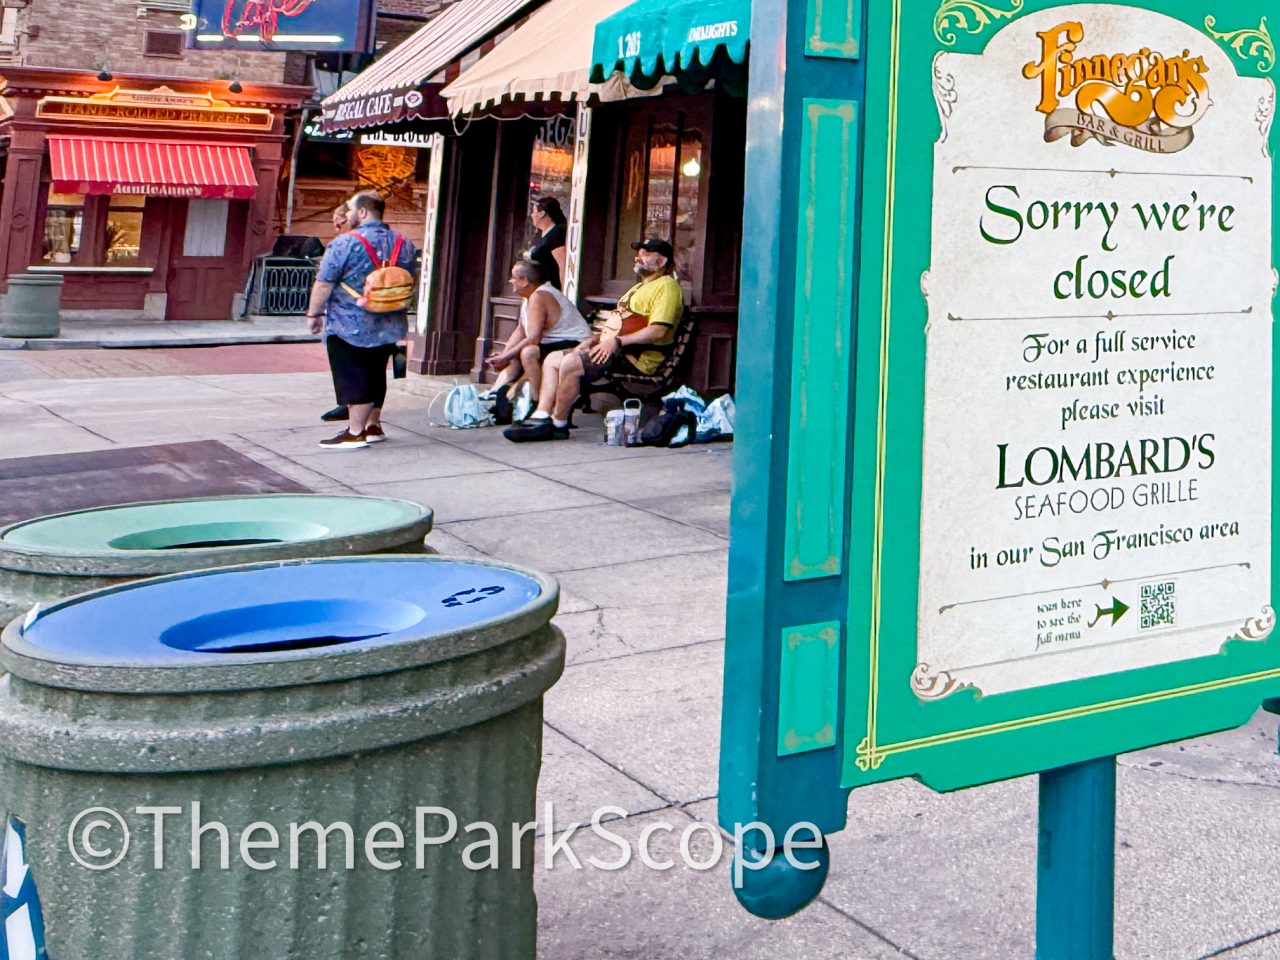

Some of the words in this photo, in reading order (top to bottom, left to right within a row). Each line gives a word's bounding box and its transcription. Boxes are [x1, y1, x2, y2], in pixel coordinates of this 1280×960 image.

[1022, 21, 1214, 128] Finnegan's
[334, 100, 365, 121] REGAL
[1077, 113, 1105, 133] BAR
[1124, 131, 1165, 152] GRILL
[980, 185, 1119, 252] Sorry
[1132, 190, 1235, 232] we're
[1054, 255, 1175, 300] closed
[1022, 333, 1069, 363] For
[1076, 339, 1087, 354] a
[1091, 330, 1126, 363] full
[1131, 329, 1196, 352] service
[1006, 368, 1109, 391] restaurant
[1117, 361, 1215, 392] experience
[1060, 399, 1120, 430] please
[1127, 394, 1165, 416] visit
[996, 433, 1216, 489] LOMBARD'S
[1014, 487, 1125, 520] SEAFOOD
[1132, 478, 1199, 507] GRILLE
[970, 546, 988, 569] in
[996, 547, 1033, 566] our
[1040, 537, 1085, 567] San
[1091, 523, 1193, 560] Francisco
[1199, 521, 1240, 541] area
[1037, 619, 1047, 630] to
[1067, 612, 1081, 624] the
[1055, 630, 1081, 642] menu
